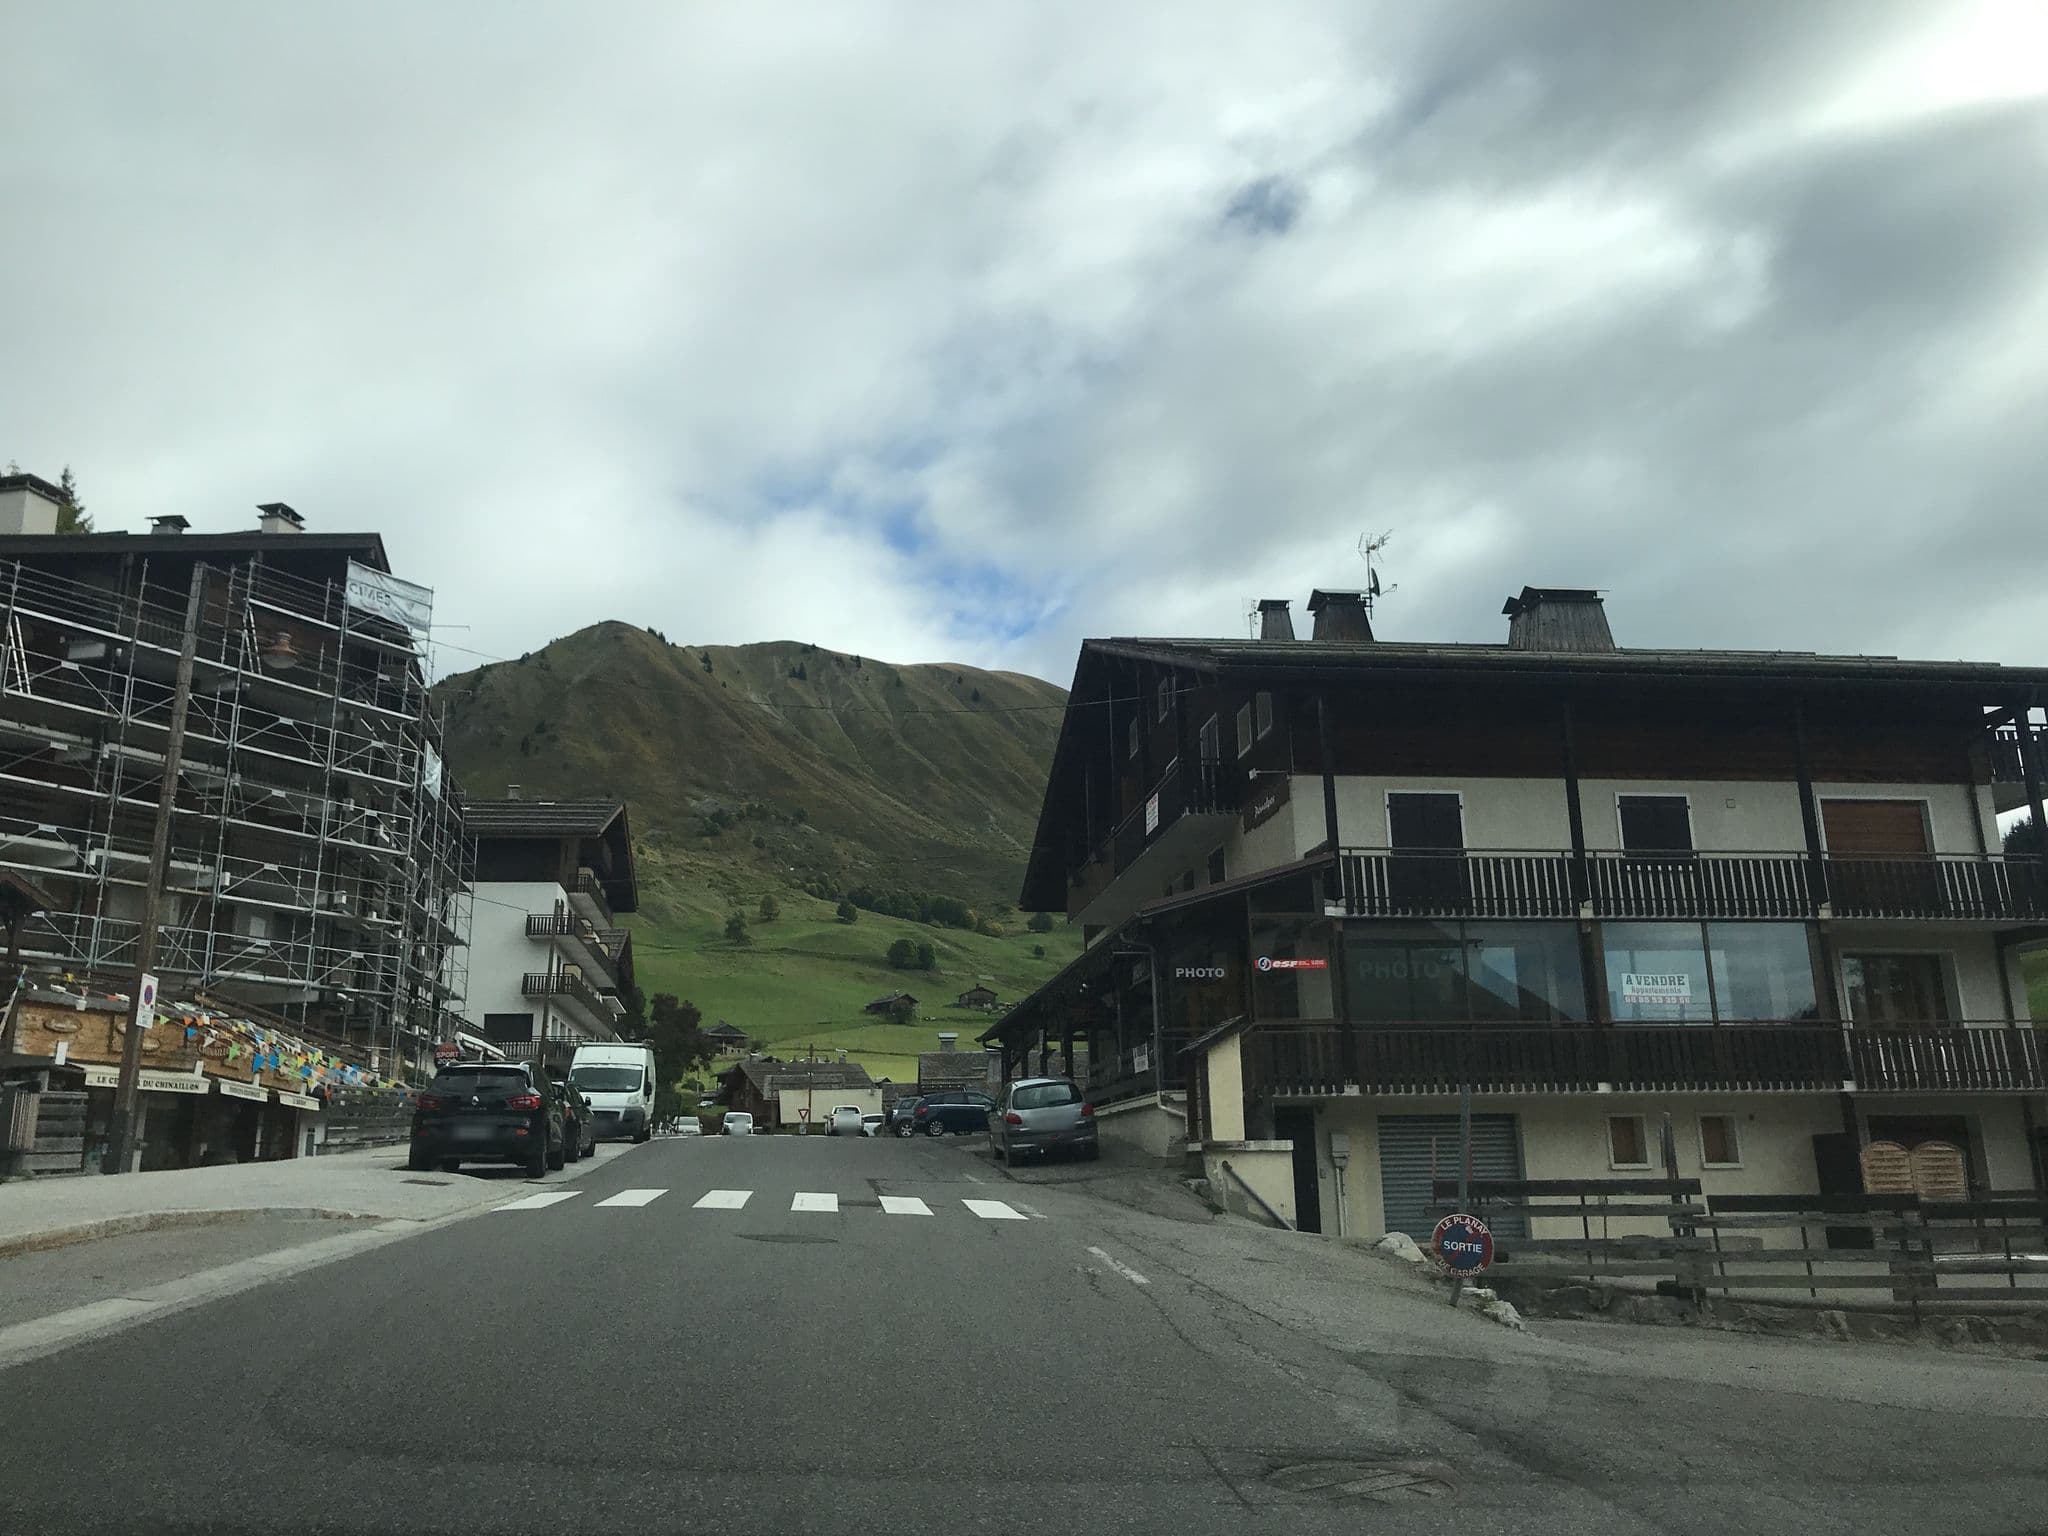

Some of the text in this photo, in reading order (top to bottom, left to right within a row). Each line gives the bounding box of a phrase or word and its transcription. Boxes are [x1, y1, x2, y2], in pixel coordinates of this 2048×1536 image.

[1175, 967, 1225, 978] PHOTO
[1626, 974, 1686, 986] A VENDRE
[436, 1051, 460, 1059] SPORT
[143, 1080, 154, 1088] DU
[155, 1081, 200, 1091] CHINAILLON
[1441, 1216, 1489, 1234] LE PLANAY
[1443, 1240, 1483, 1253] SORTIE
[1450, 1262, 1486, 1278] GARAGE
